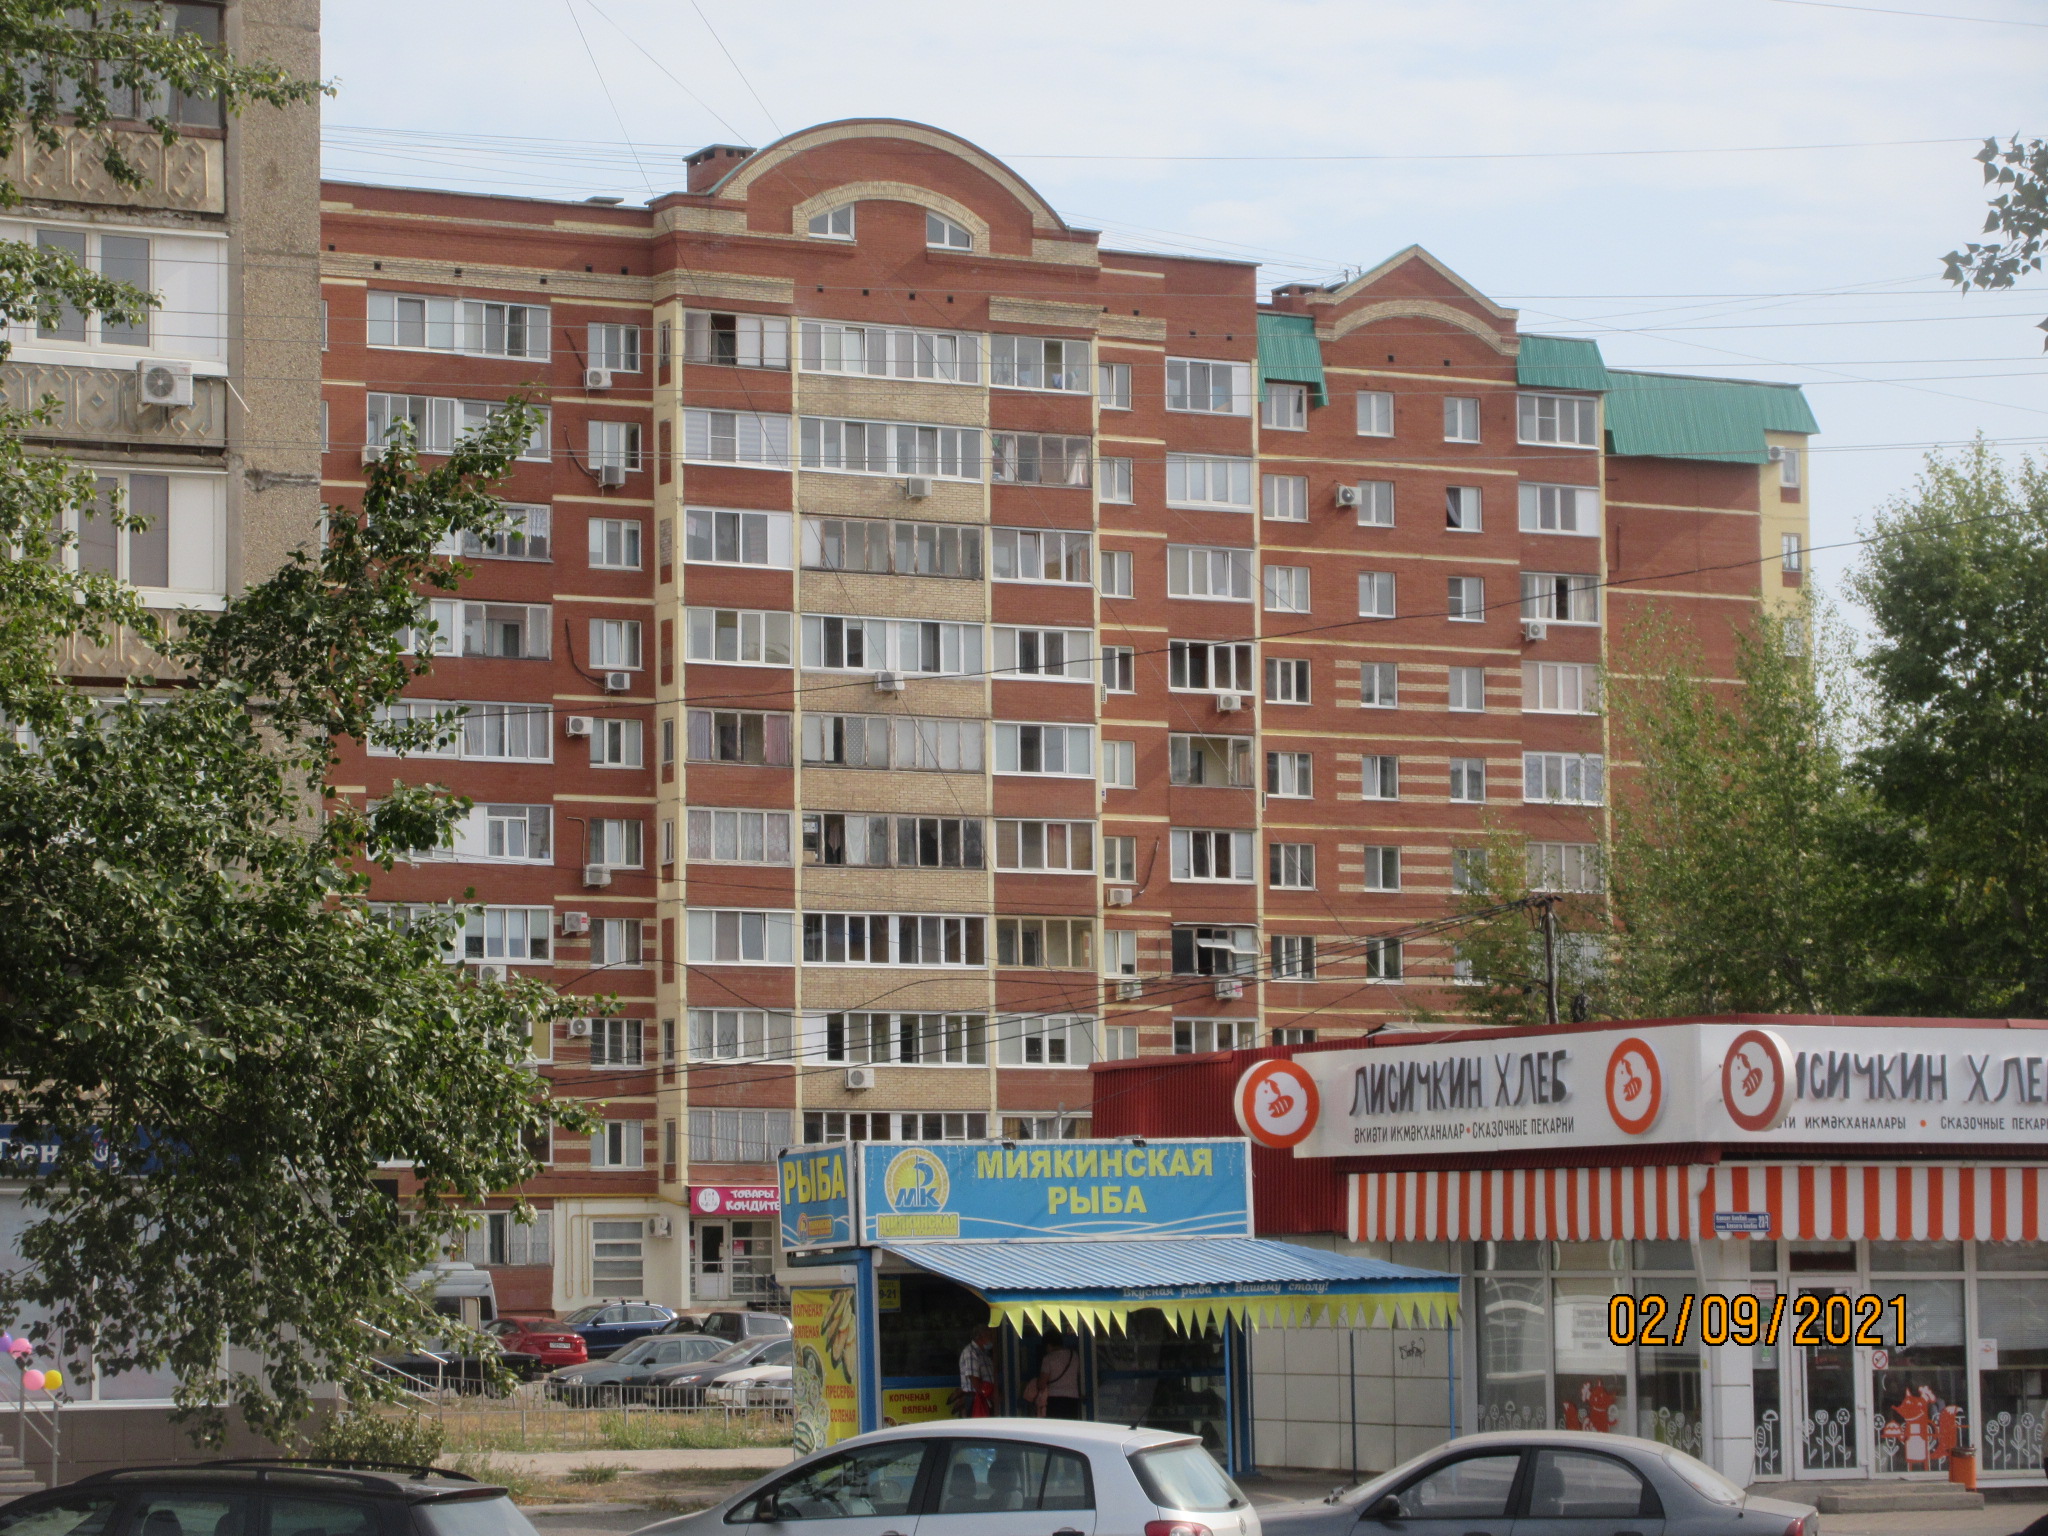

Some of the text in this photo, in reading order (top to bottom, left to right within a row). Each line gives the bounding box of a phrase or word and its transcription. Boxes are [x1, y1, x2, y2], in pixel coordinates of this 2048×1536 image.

[1349, 1049, 1568, 1116] ЛИСИЧКИН ХЛЕБ
[1967, 1054, 2048, 1102] ХЛЕ
[1472, 1119, 1527, 1139] СКАЗОЧНЫЕ
[1530, 1116, 1575, 1135] ПЕКАРНИ
[1940, 1115, 2005, 1130] СКАЗОЧНЫЕ
[2011, 1116, 2048, 1130] ПЕКАР
[976, 1148, 1213, 1179] МИЯКИНСКАЯ
[783, 1154, 847, 1206] РЫБА
[730, 1189, 774, 1199] ТОВАРЫ
[1048, 1185, 1148, 1215] РЫБА
[1122, 1287, 1174, 1299] Вкусная
[1181, 1284, 1212, 1298] рыба
[1219, 1285, 1227, 1293] к
[1235, 1282, 1282, 1294] Вашему
[825, 1384, 856, 1399] ПРЕСЕРВЫ
[889, 1392, 930, 1402] КОПЧЕНАЯ
[902, 1404, 938, 1415] ВЯЛЕНАЯ
